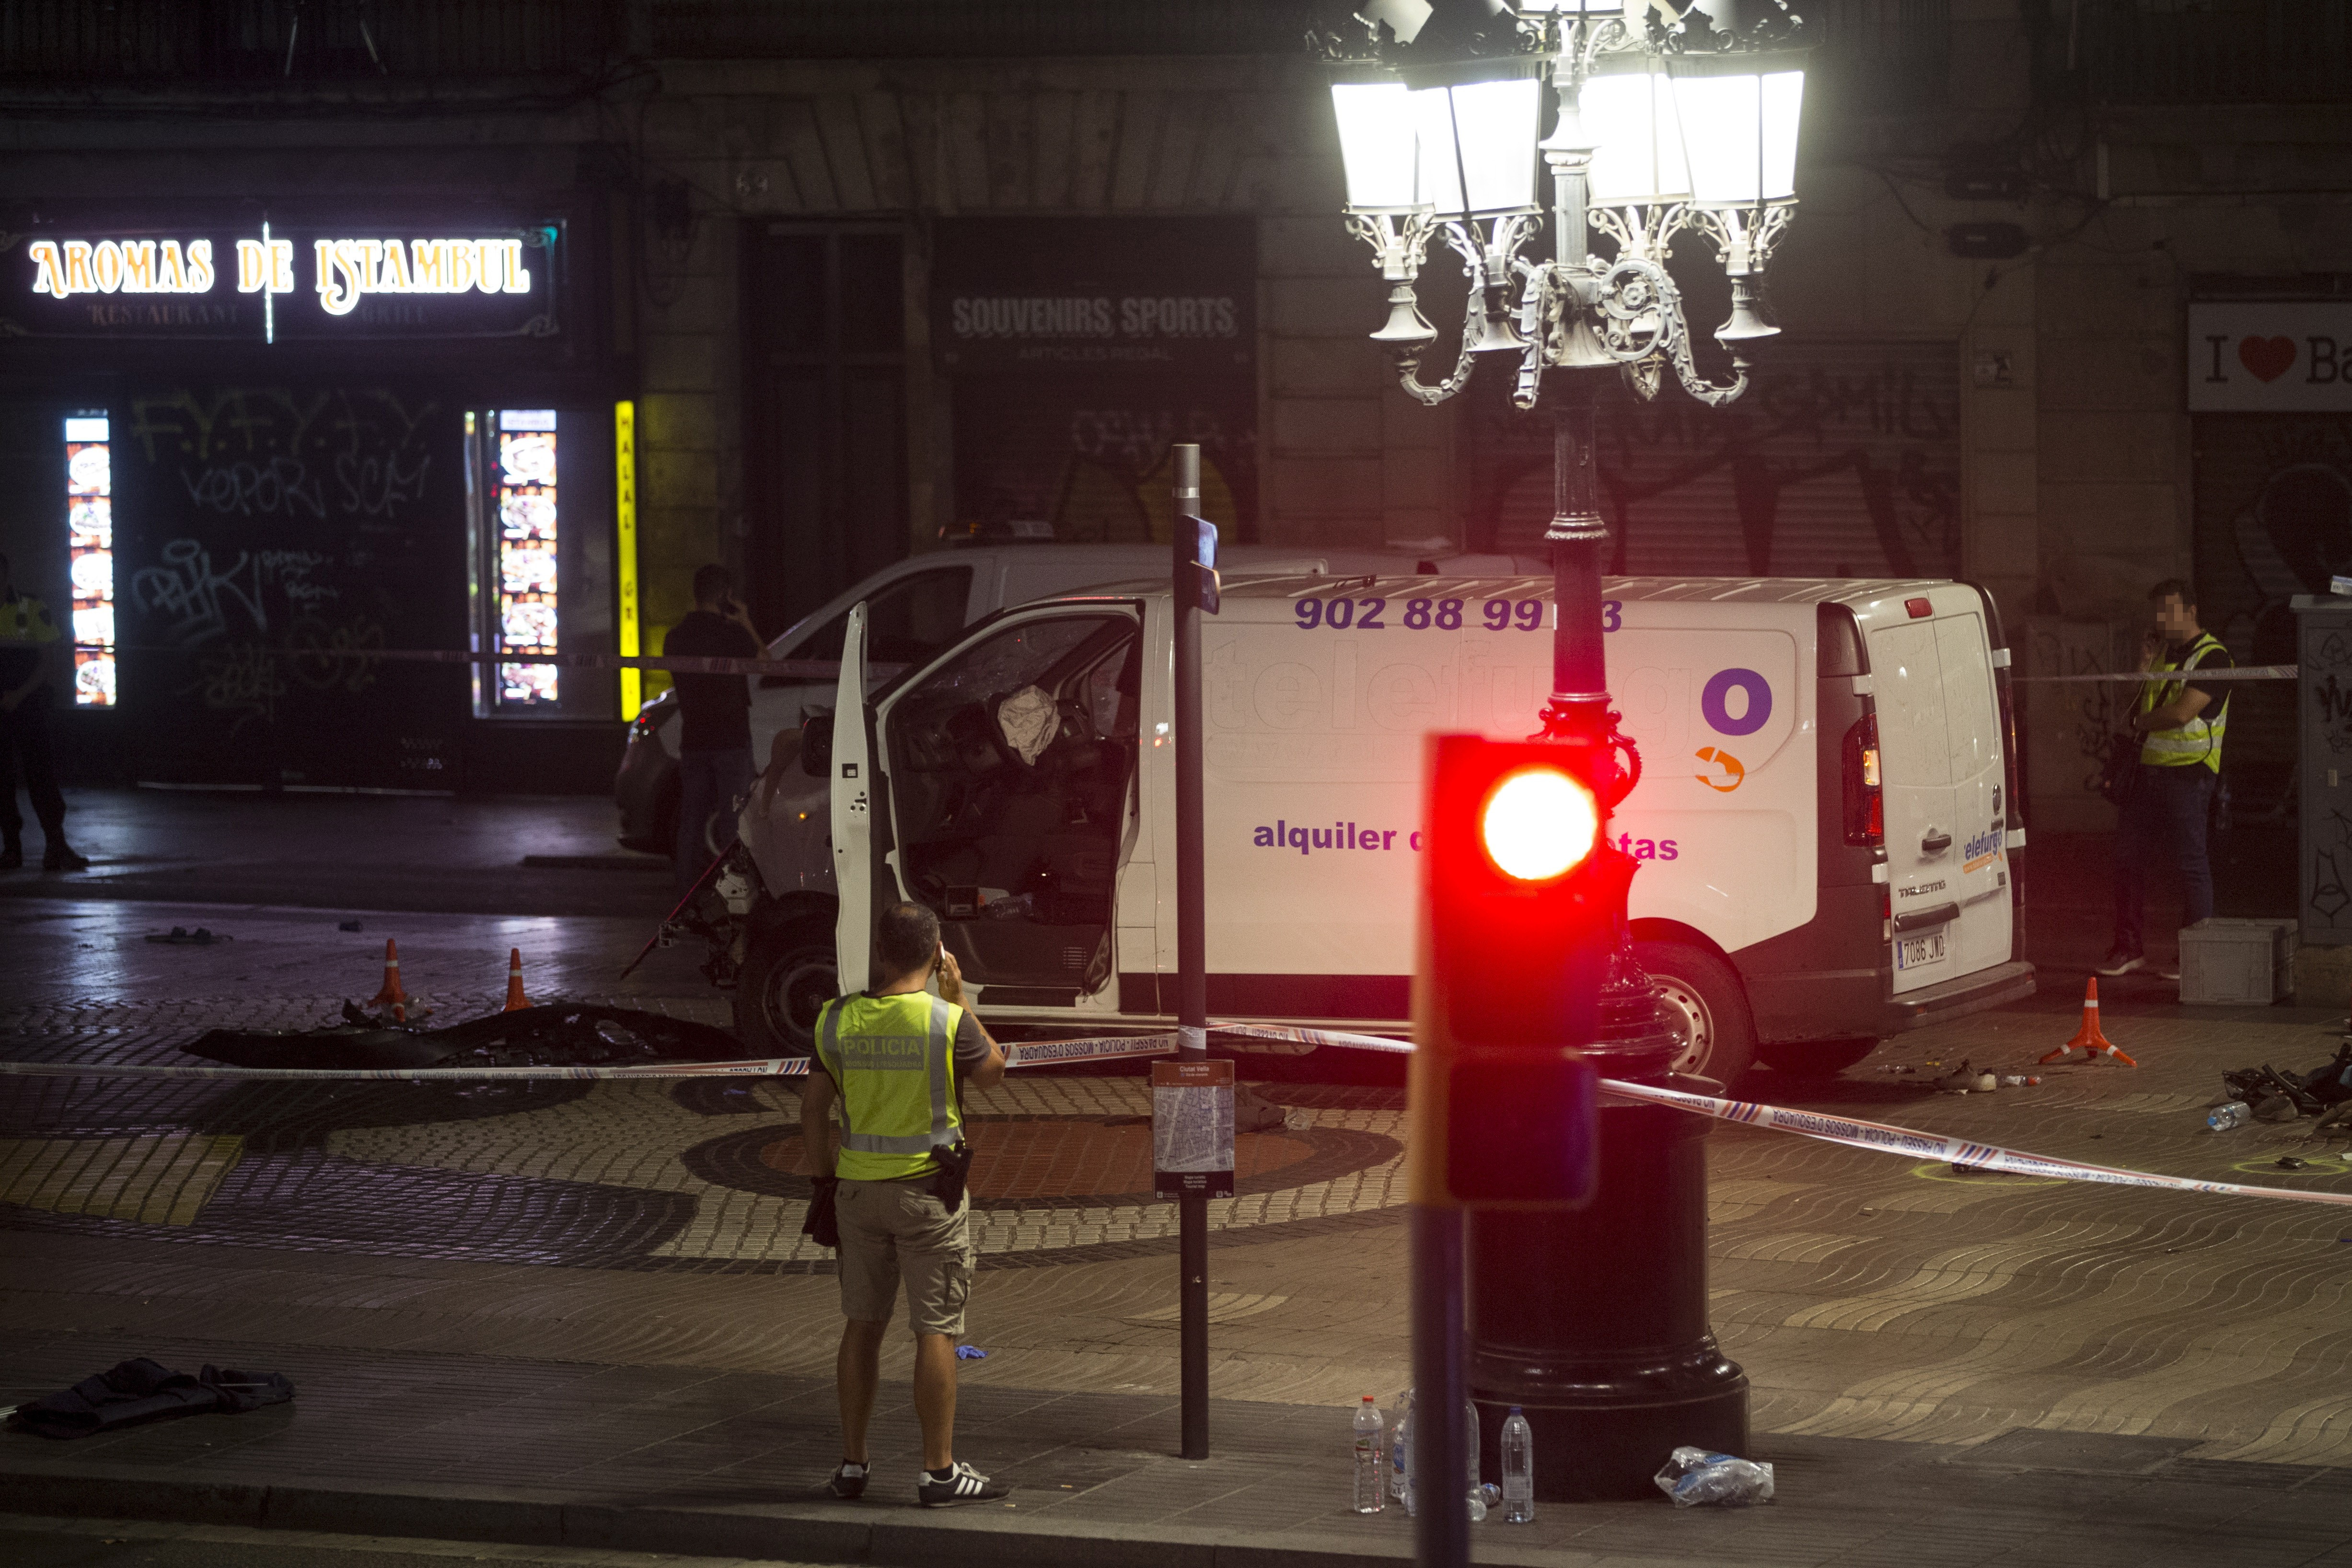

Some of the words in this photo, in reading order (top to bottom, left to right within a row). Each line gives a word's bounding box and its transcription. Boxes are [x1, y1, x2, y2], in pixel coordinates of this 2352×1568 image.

[29, 239, 215, 299] AROMAS
[237, 239, 294, 294] DE
[314, 239, 530, 315] ISTAMBUL
[952, 297, 1111, 336] SOUVENIRS
[1122, 297, 1235, 336] SPORTS
[2206, 336, 2229, 383] I
[1295, 598, 1386, 629] 902
[1403, 598, 1464, 630] 88
[1483, 599, 1543, 631] 99
[1253, 820, 1397, 855] alquiler
[1964, 828, 2003, 860] elefurgo
[1904, 939, 1926, 965] 7086
[844, 1038, 921, 1056] POLICIA
[1065, 1042, 1094, 1057] MOSSOS
[1825, 1117, 1859, 1139] MOSSOS
[1865, 1127, 1896, 1147] POLICIA
[1900, 1135, 1933, 1153] PASSEU
